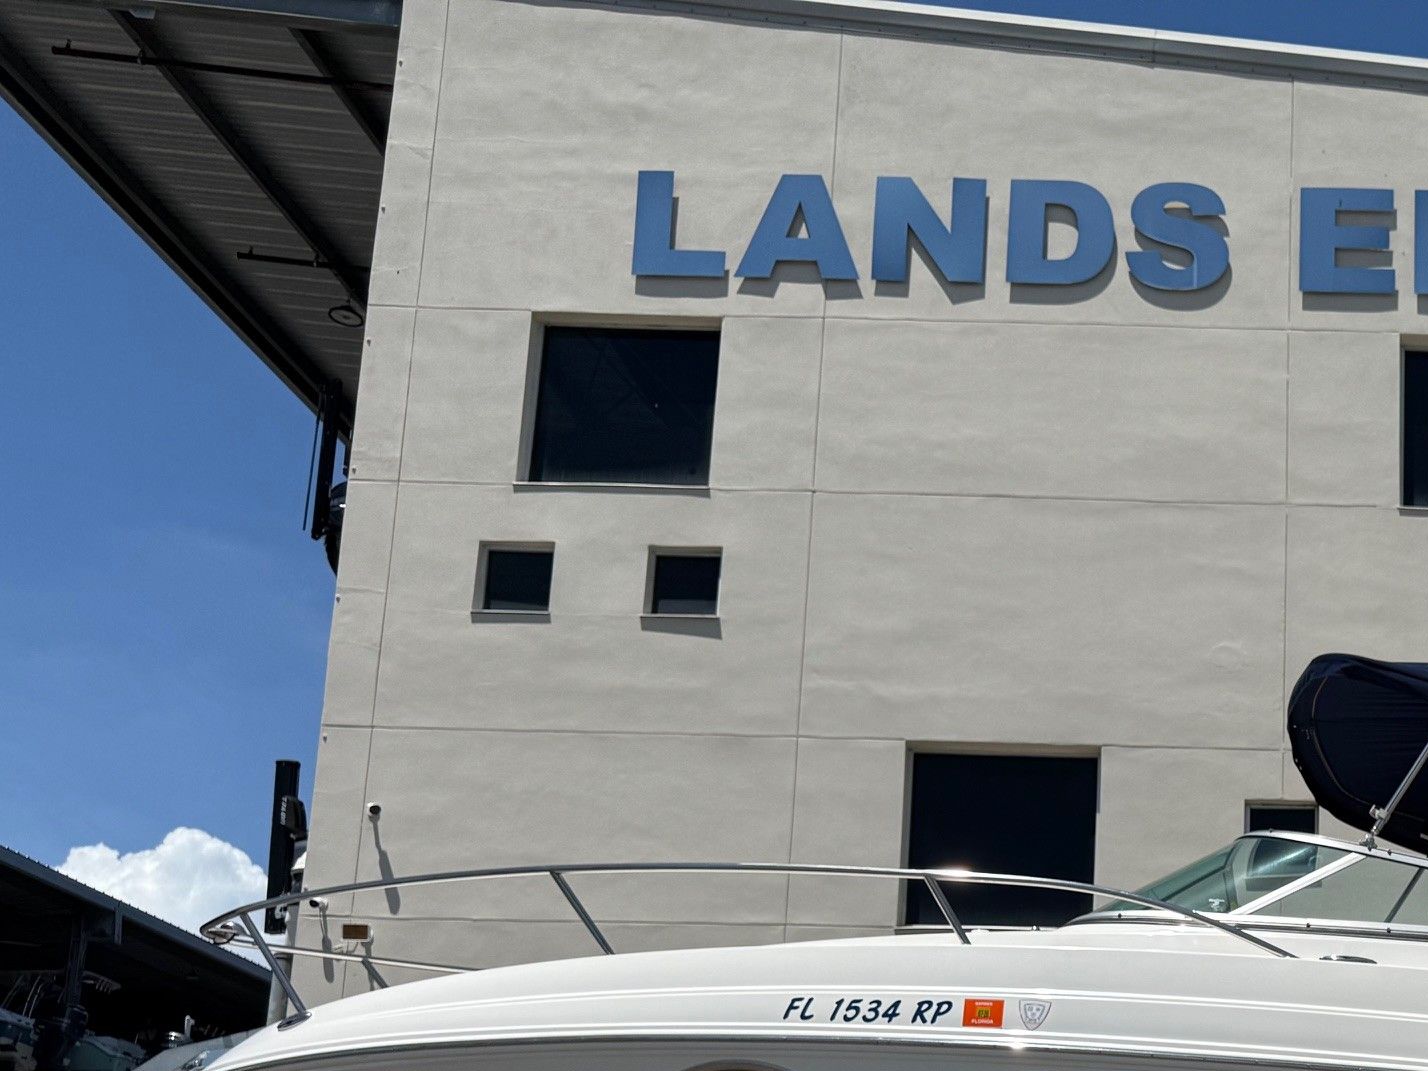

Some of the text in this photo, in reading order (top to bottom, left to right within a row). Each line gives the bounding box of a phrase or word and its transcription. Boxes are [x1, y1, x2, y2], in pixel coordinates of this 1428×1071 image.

[631, 169, 1231, 291] LANDS
[782, 997, 954, 1024] FL 1534 RP
